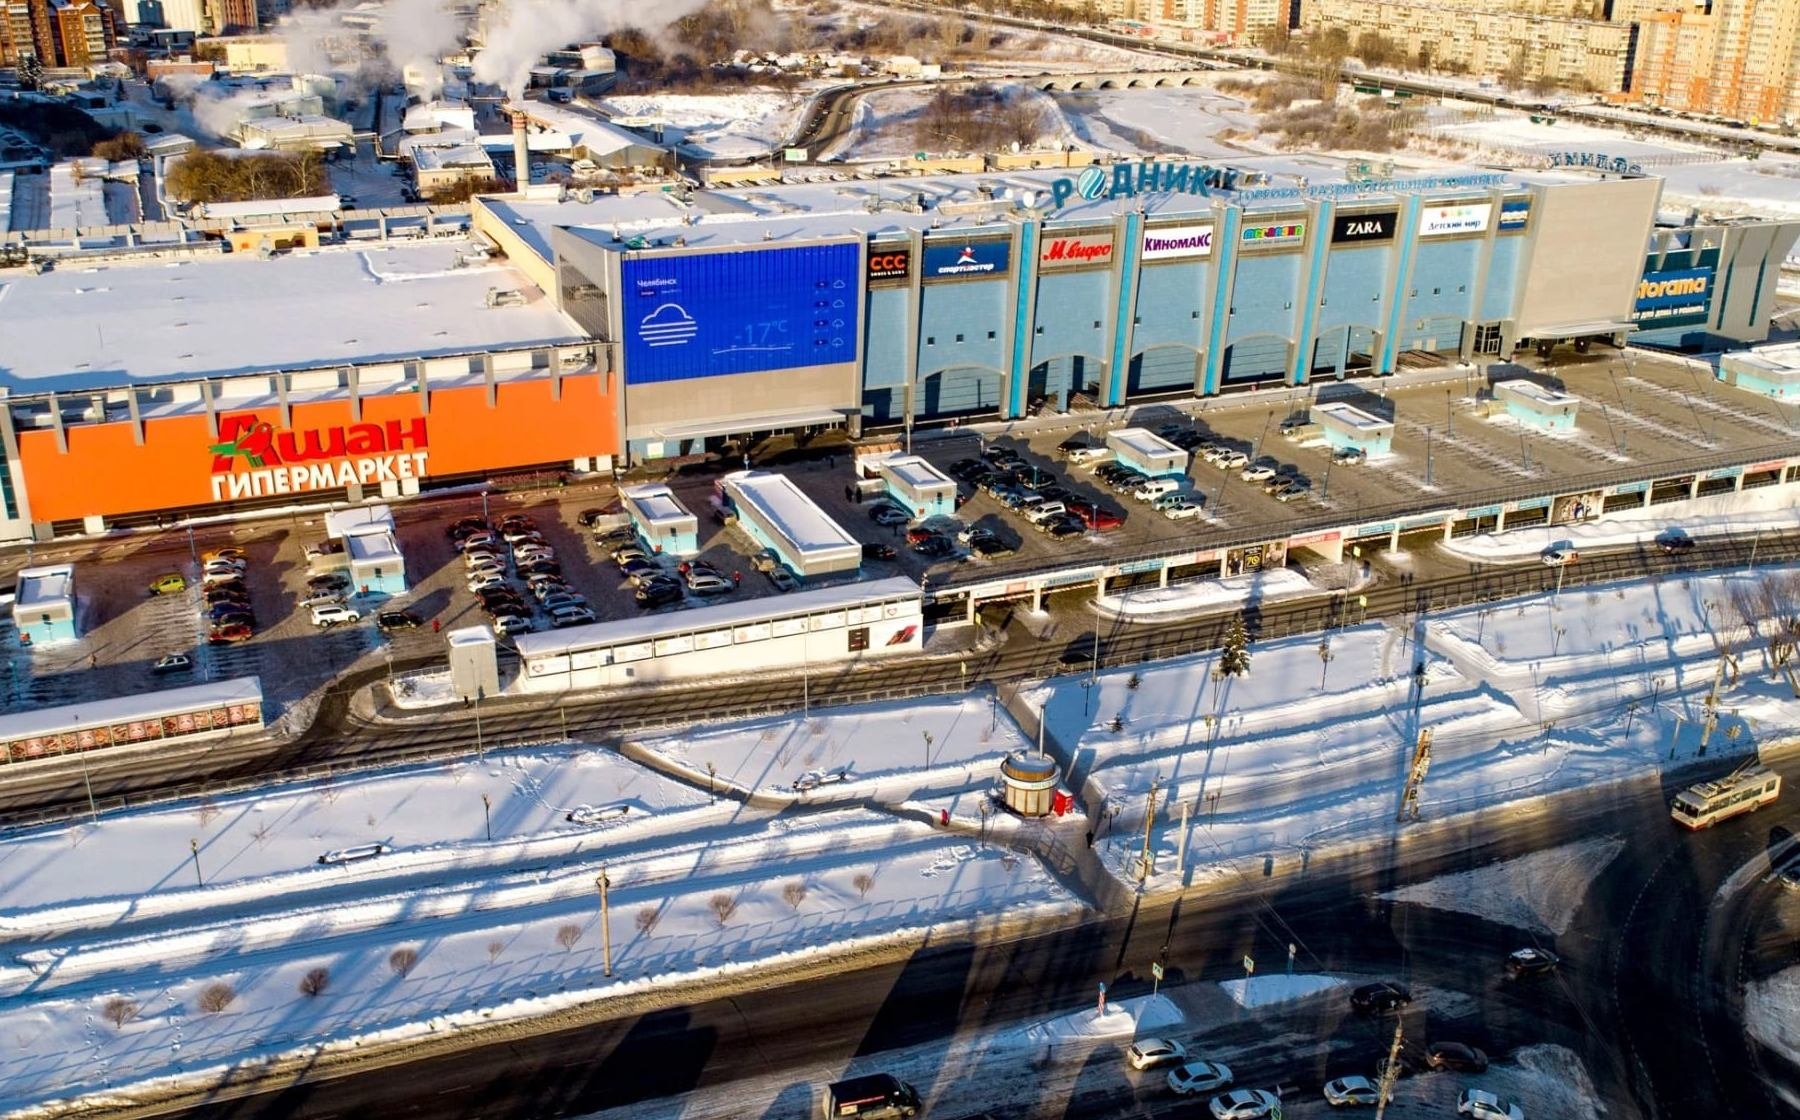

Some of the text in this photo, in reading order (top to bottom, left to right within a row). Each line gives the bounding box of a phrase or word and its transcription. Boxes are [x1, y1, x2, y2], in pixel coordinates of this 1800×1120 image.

[1346, 221, 1384, 236] ZARA
[636, 278, 677, 288] Челябинск
[211, 414, 429, 473] Ашан
[211, 452, 429, 502] ГИПЕРМАРКЕТ
